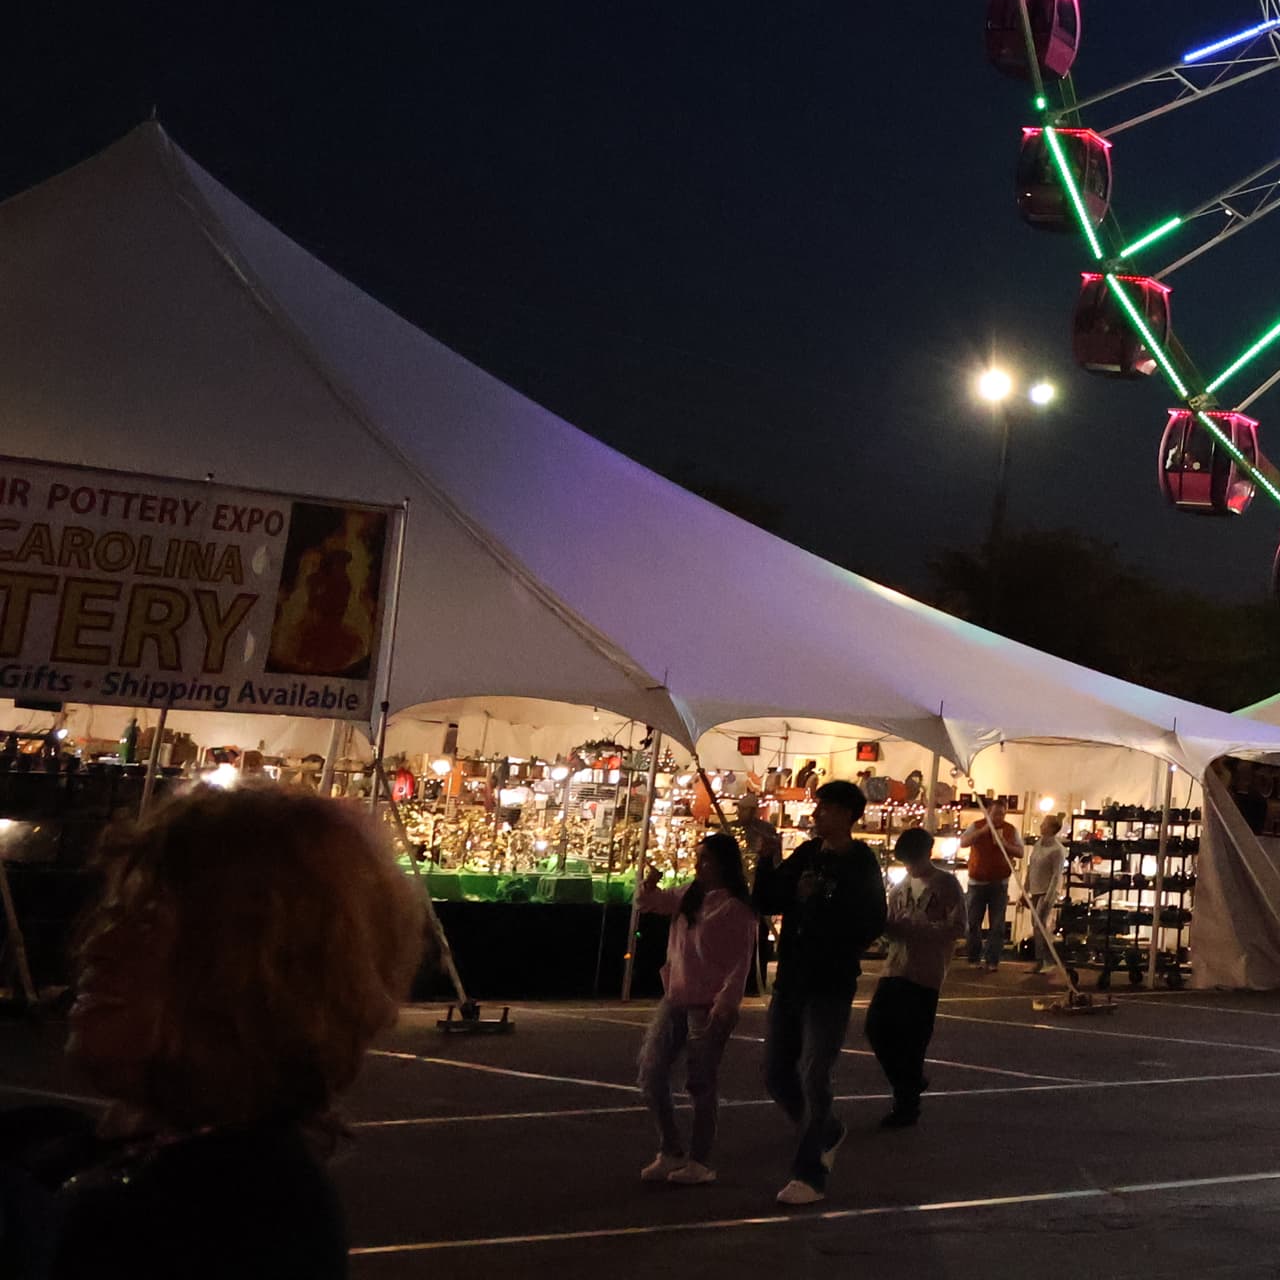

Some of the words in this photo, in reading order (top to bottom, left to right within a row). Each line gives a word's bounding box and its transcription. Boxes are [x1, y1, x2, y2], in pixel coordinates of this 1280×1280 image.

[48, 484, 202, 527] POTTERY
[212, 504, 285, 537] EXPO
[0, 664, 73, 693] Gifts
[101, 672, 230, 708] Shipping
[237, 681, 359, 711] Available
